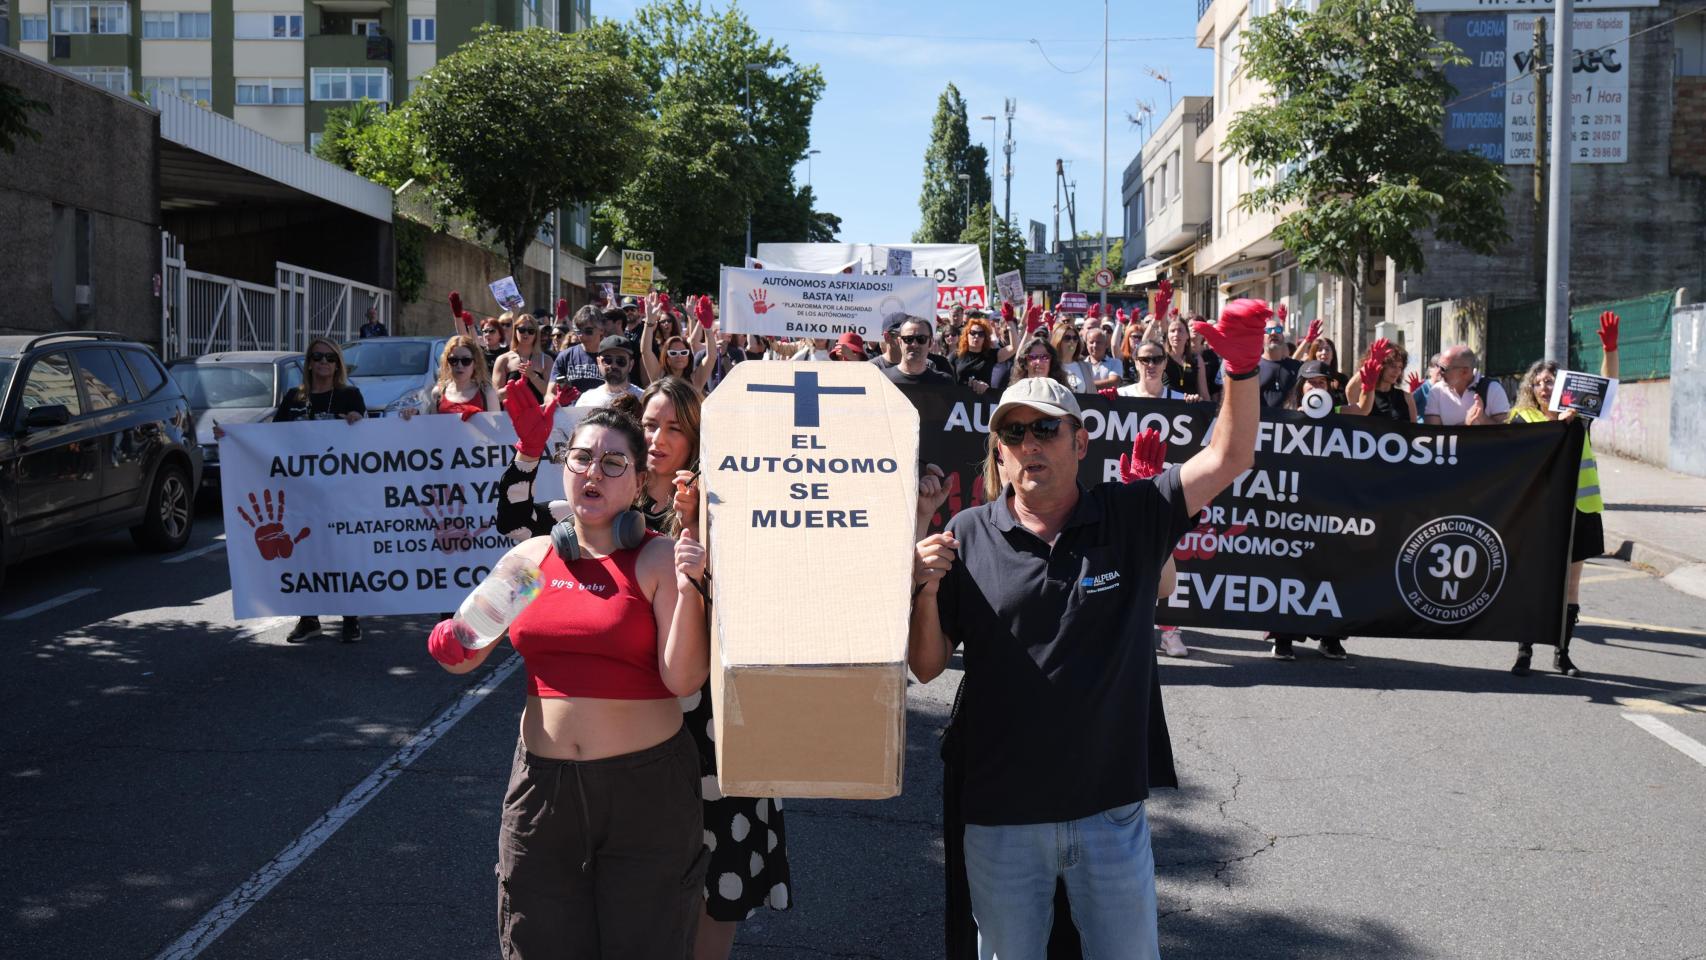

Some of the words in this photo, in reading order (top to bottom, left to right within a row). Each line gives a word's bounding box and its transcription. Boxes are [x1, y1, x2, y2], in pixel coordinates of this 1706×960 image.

[1466, 20, 1505, 38] CADENA
[1479, 52, 1505, 68] LIDER
[1586, 86, 1592, 104] 1
[1598, 90, 1622, 104] Hora
[1452, 112, 1504, 129] TINTORERIA
[1510, 148, 1530, 159] LOPEZ
[624, 252, 652, 262] VIGO
[763, 276, 826, 289] AUTÓNOMOS
[828, 280, 893, 292] ASFIXIADOS!!
[802, 291, 832, 301] BASTA
[834, 293, 853, 302] YA!!
[786, 322, 828, 333] BAIXO
[831, 324, 867, 335] MIÑO
[791, 434, 827, 450] EL
[270, 446, 443, 477] AUTÓNOMOS
[718, 454, 898, 474] AUTÓNOMO
[384, 483, 467, 508] BASTA
[789, 483, 829, 500] SE
[443, 516, 474, 530] POR
[479, 515, 498, 529] LA
[751, 509, 869, 528] MUERE
[1231, 507, 1260, 527] LA
[1265, 510, 1376, 536] DIGNIDAD
[374, 540, 393, 554] DE
[397, 539, 427, 553] LOS
[1402, 521, 1475, 564] MANIFESTACION
[1475, 528, 1502, 571] NACIONAL
[1428, 542, 1478, 579] 30
[280, 569, 409, 594] SANTIAGO
[416, 567, 448, 590] DE
[1094, 570, 1120, 584] ALPEBA
[578, 582, 606, 592] baby
[1441, 580, 1459, 600] N
[1407, 591, 1423, 606] DE
[1420, 592, 1490, 619] AUTONOMOS
